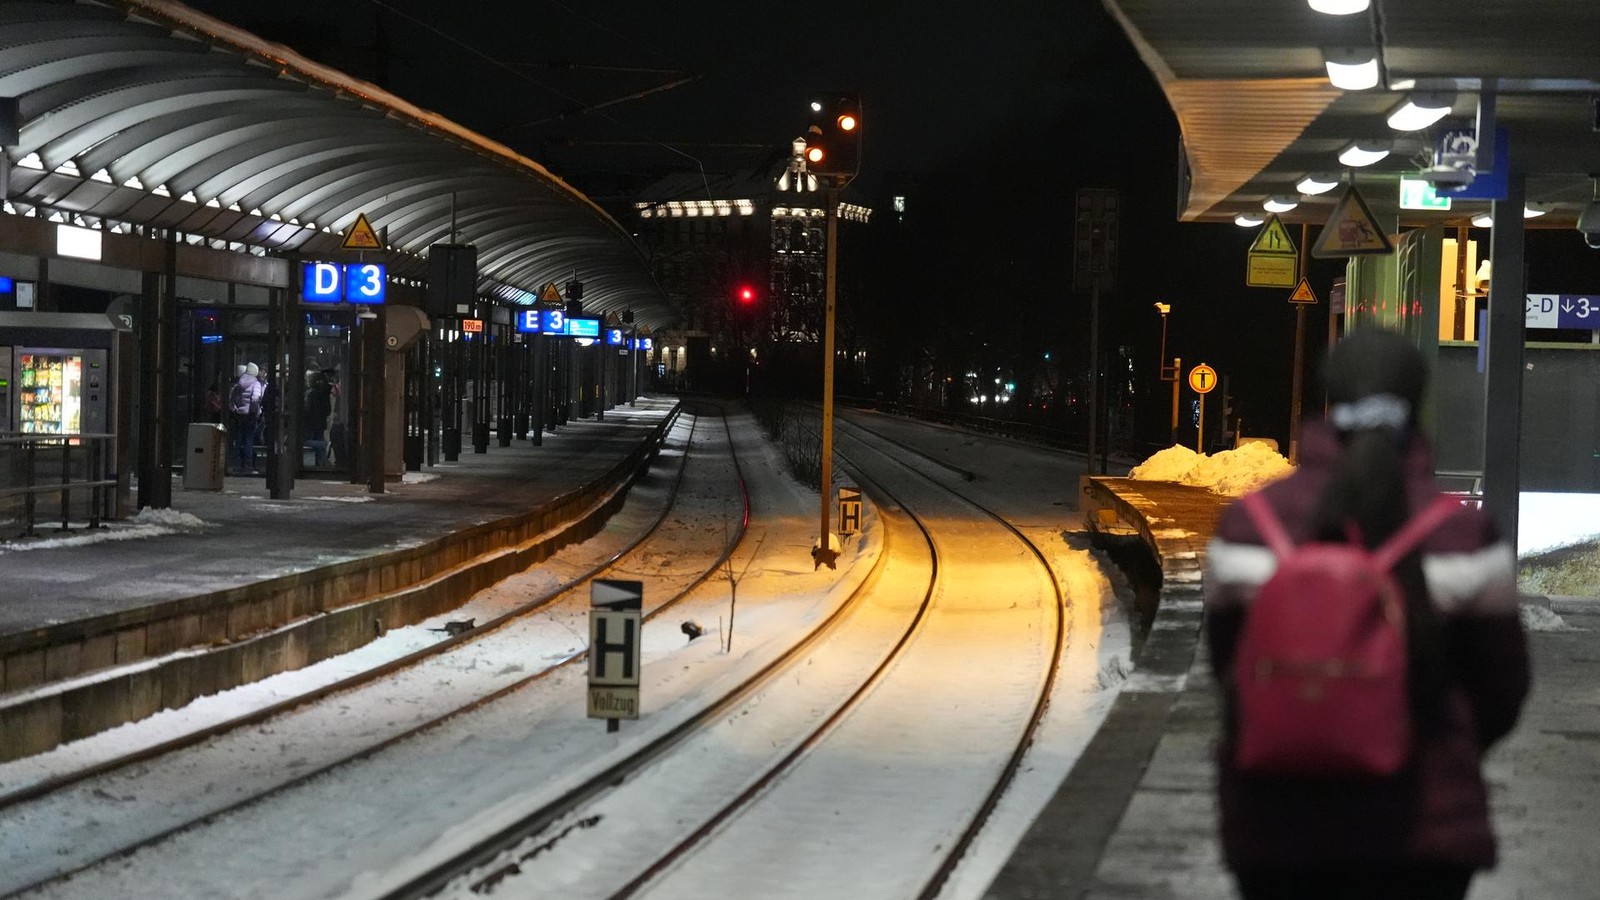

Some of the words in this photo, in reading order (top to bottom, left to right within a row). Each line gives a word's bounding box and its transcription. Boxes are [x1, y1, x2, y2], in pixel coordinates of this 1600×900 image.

[315, 263, 338, 294] D
[360, 264, 381, 296] 3
[526, 310, 538, 328] E
[549, 311, 562, 329] 3
[612, 330, 622, 342] 3
[841, 503, 860, 530] H
[595, 618, 634, 678] H
[591, 691, 634, 715] Vollzug
